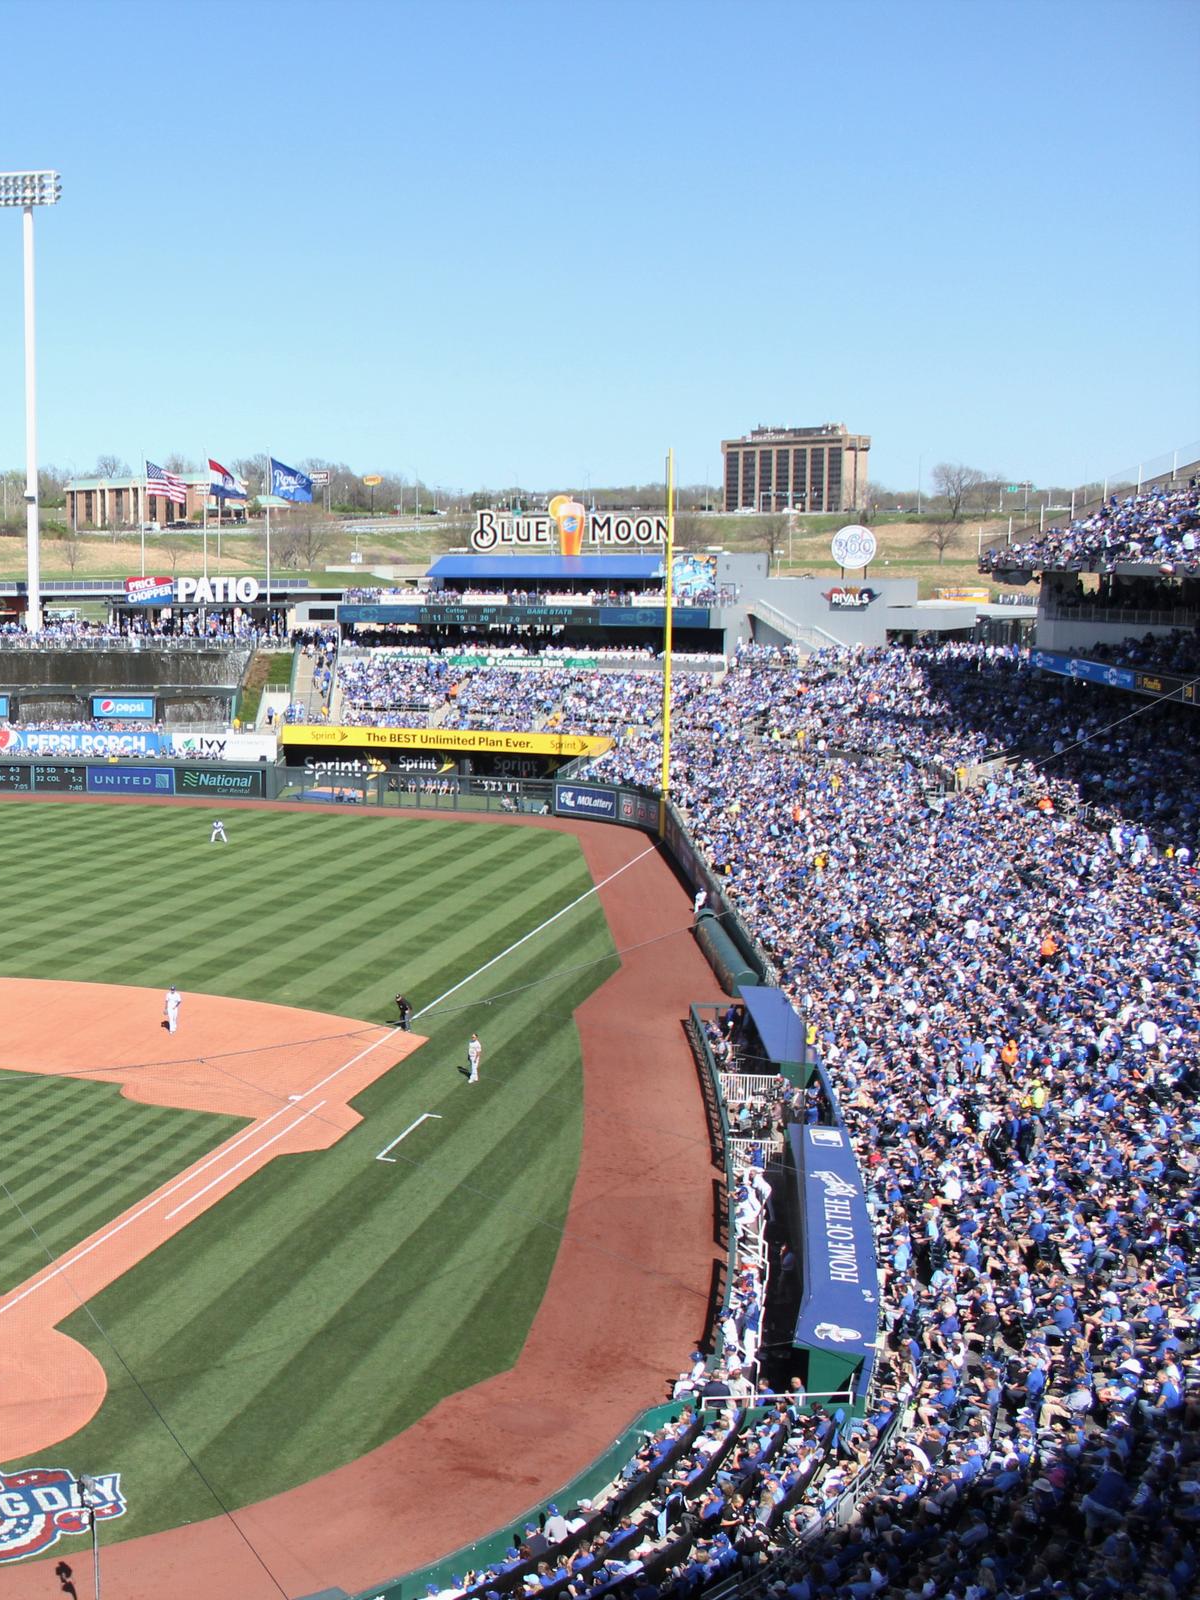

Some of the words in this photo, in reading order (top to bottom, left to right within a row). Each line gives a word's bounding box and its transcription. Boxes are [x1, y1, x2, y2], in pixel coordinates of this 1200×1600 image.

[835, 534, 874, 563] 360
[128, 577, 156, 590] PRICE
[177, 576, 260, 603] PATIO
[127, 586, 172, 604] CHOPPER
[831, 592, 870, 604] RIVALS
[496, 658, 541, 667] Commerce
[542, 658, 564, 668] Bank
[115, 701, 145, 714] pepsi
[27, 734, 79, 750] PEPSI
[81, 735, 146, 751] PORCH
[200, 737, 227, 753] Ivy
[311, 731, 336, 741] Sprint
[366, 732, 387, 743] The
[389, 733, 417, 744] BEST
[420, 734, 475, 747] Unlimited
[478, 736, 503, 747] Plan
[505, 738, 534, 749] Ever.
[550, 740, 576, 751] Sprint
[304, 756, 362, 780] Sprint
[399, 755, 438, 772] Sprint
[493, 756, 538, 776] Sprint
[94, 775, 152, 786] UNITED
[199, 772, 253, 787] National
[230, 786, 251, 794] Rental
[576, 795, 613, 811] MOLottery
[823, 1197, 853, 1221] THE
[825, 1225, 855, 1241] OF
[827, 1242, 860, 1284] HOME
